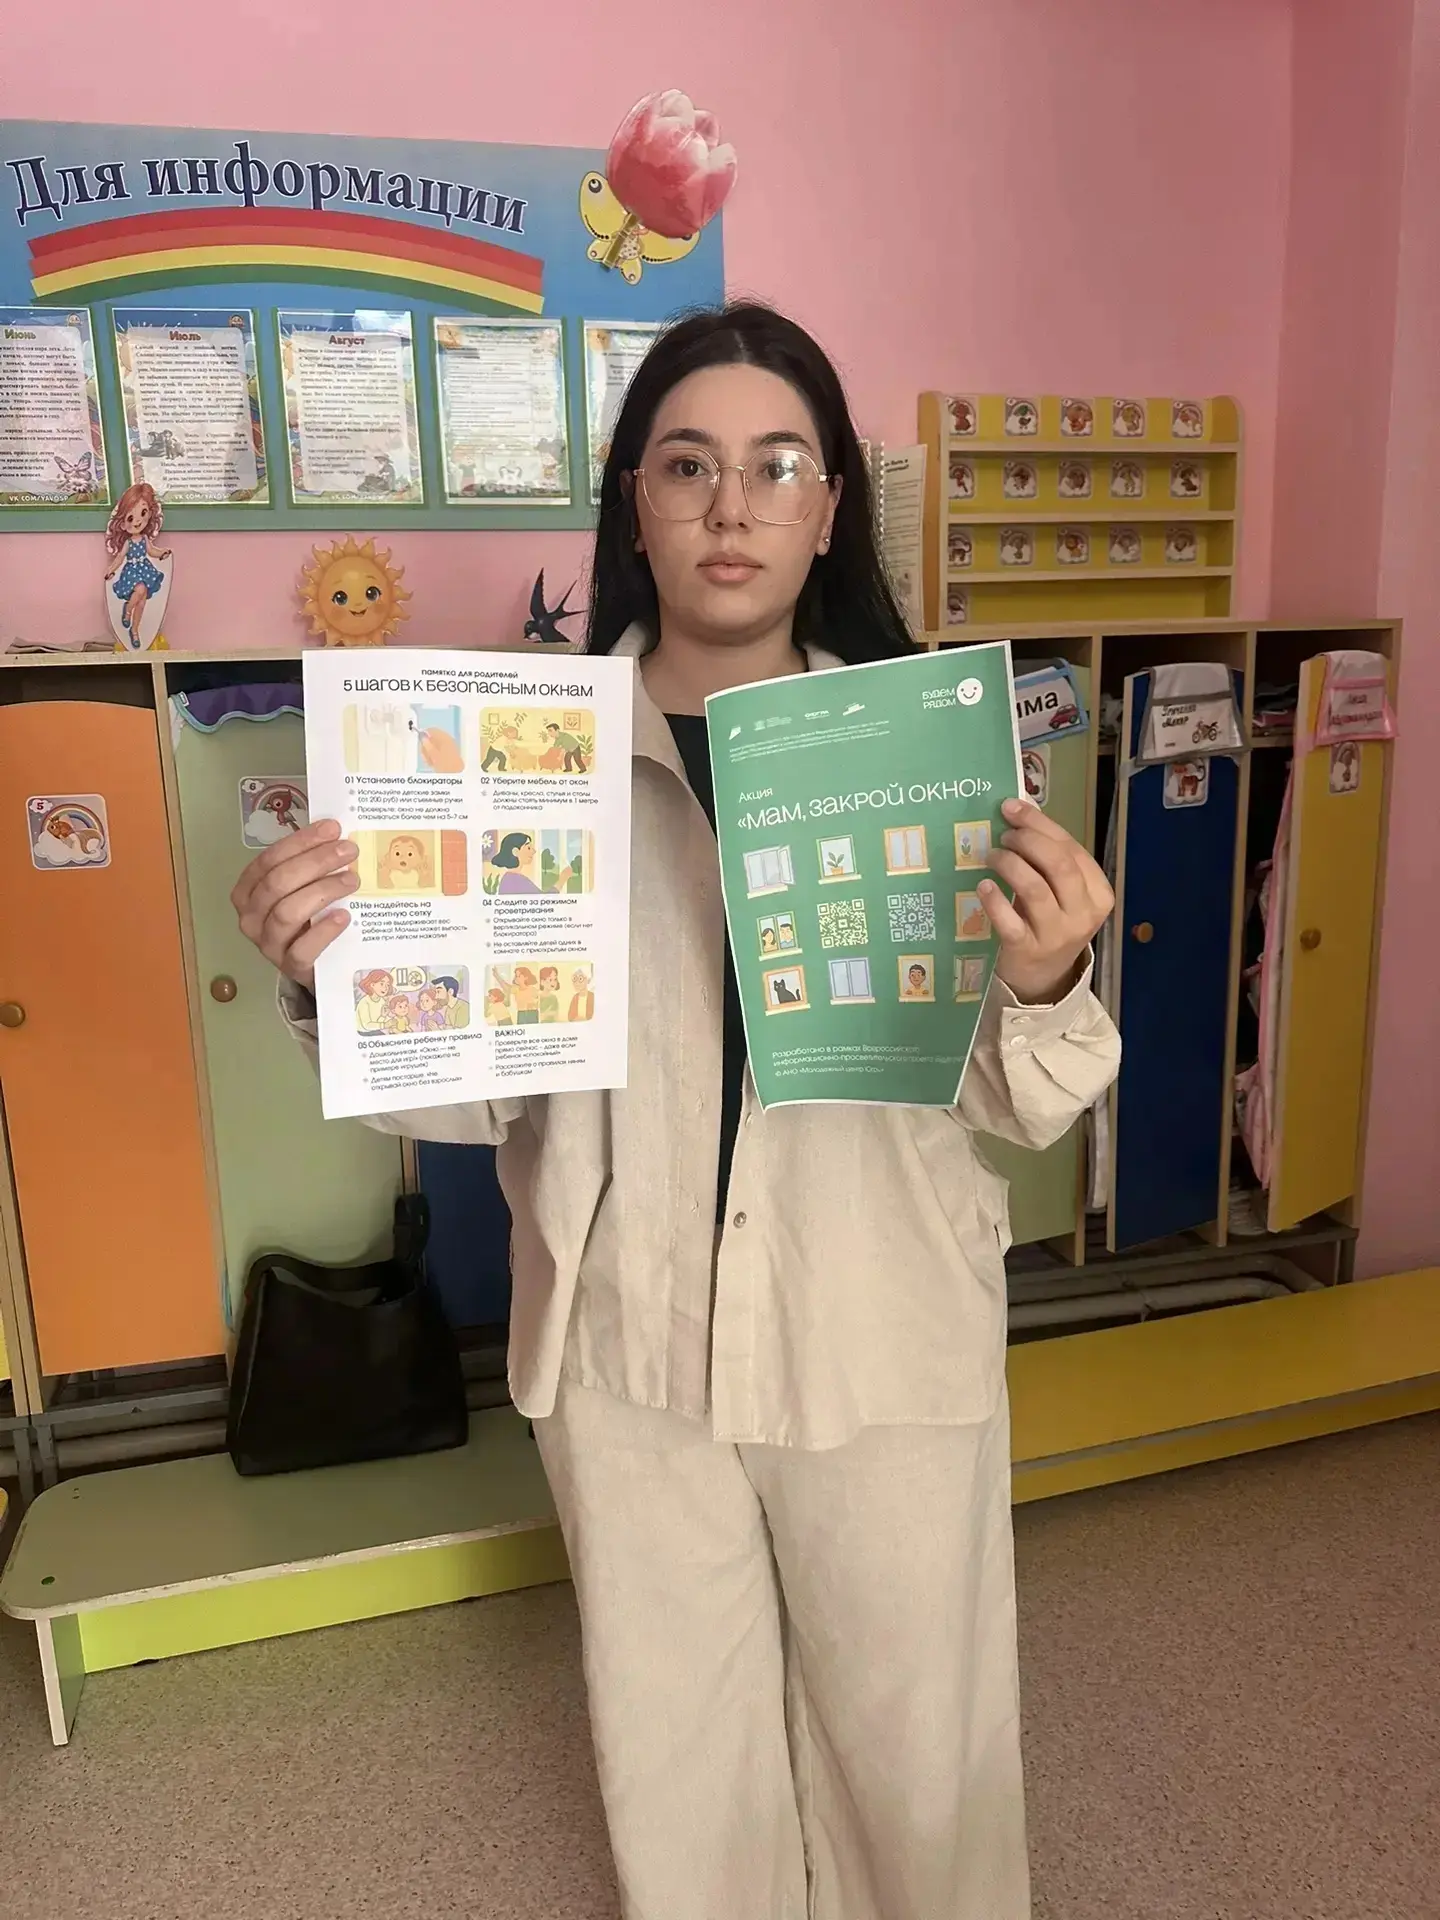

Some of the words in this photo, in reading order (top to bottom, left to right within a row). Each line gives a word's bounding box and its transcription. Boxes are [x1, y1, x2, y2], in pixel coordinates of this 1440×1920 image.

[5, 156, 132, 226] Для
[141, 140, 528, 234] информации
[4, 329, 36, 339] Июнь
[169, 331, 201, 341] Июль
[329, 335, 365, 347] Август
[421, 668, 456, 677] памятка
[458, 670, 473, 678] для
[474, 670, 519, 679] родителей
[343, 679, 353, 692] 5
[345, 776, 354, 784] 01
[356, 776, 405, 784] Установите
[407, 776, 463, 786] блокираторы
[492, 777, 526, 785] Уберите
[250, 782, 256, 791] 6
[738, 787, 773, 803] Акция
[908, 778, 992, 806] ОКНО!»
[37, 802, 44, 811] 5
[373, 901, 419, 909] надейтесь
[494, 898, 528, 906] Следите
[361, 910, 407, 918] москитную
[495, 1029, 525, 1037] ВАЖНО!
[368, 1039, 412, 1048] Объясните
[413, 1035, 447, 1045] ребенку
[449, 1033, 483, 1041] правила
